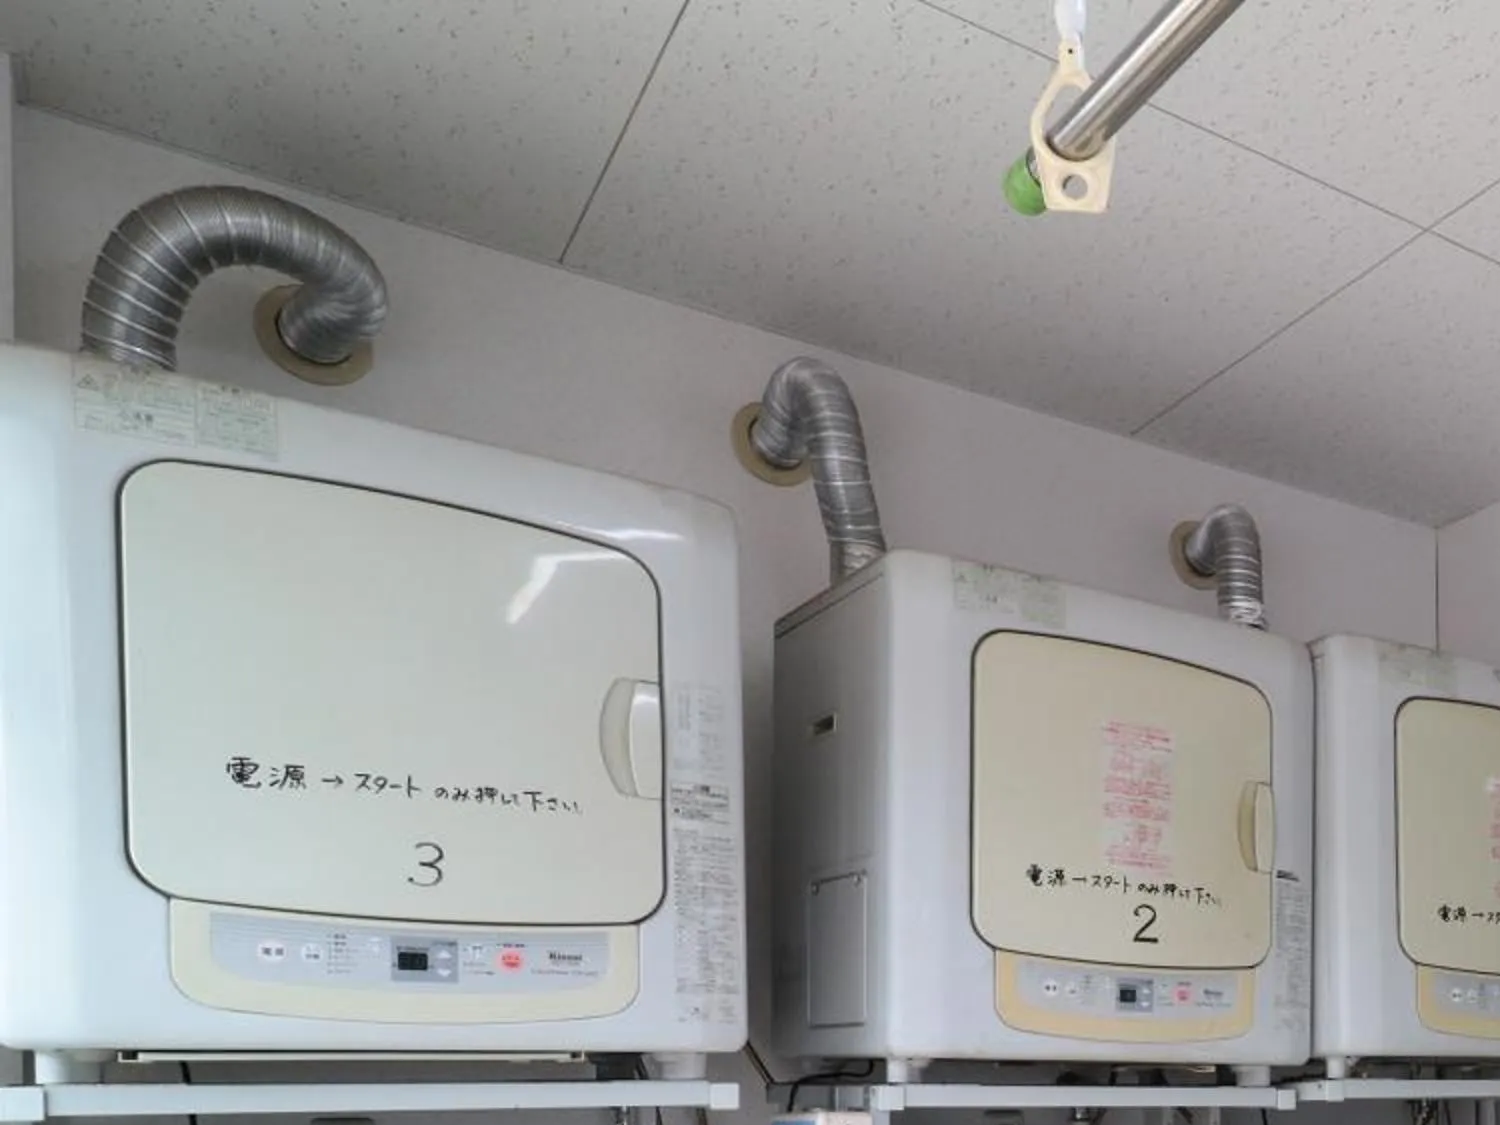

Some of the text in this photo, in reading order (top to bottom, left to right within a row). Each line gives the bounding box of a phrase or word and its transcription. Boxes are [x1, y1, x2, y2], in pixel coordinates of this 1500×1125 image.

[225, 757, 306, 789] 電源
[353, 774, 421, 799] スタート
[407, 841, 445, 888] 3
[1027, 864, 1066, 887] 電源
[1091, 875, 1131, 894] スタート
[1132, 904, 1159, 944] 2
